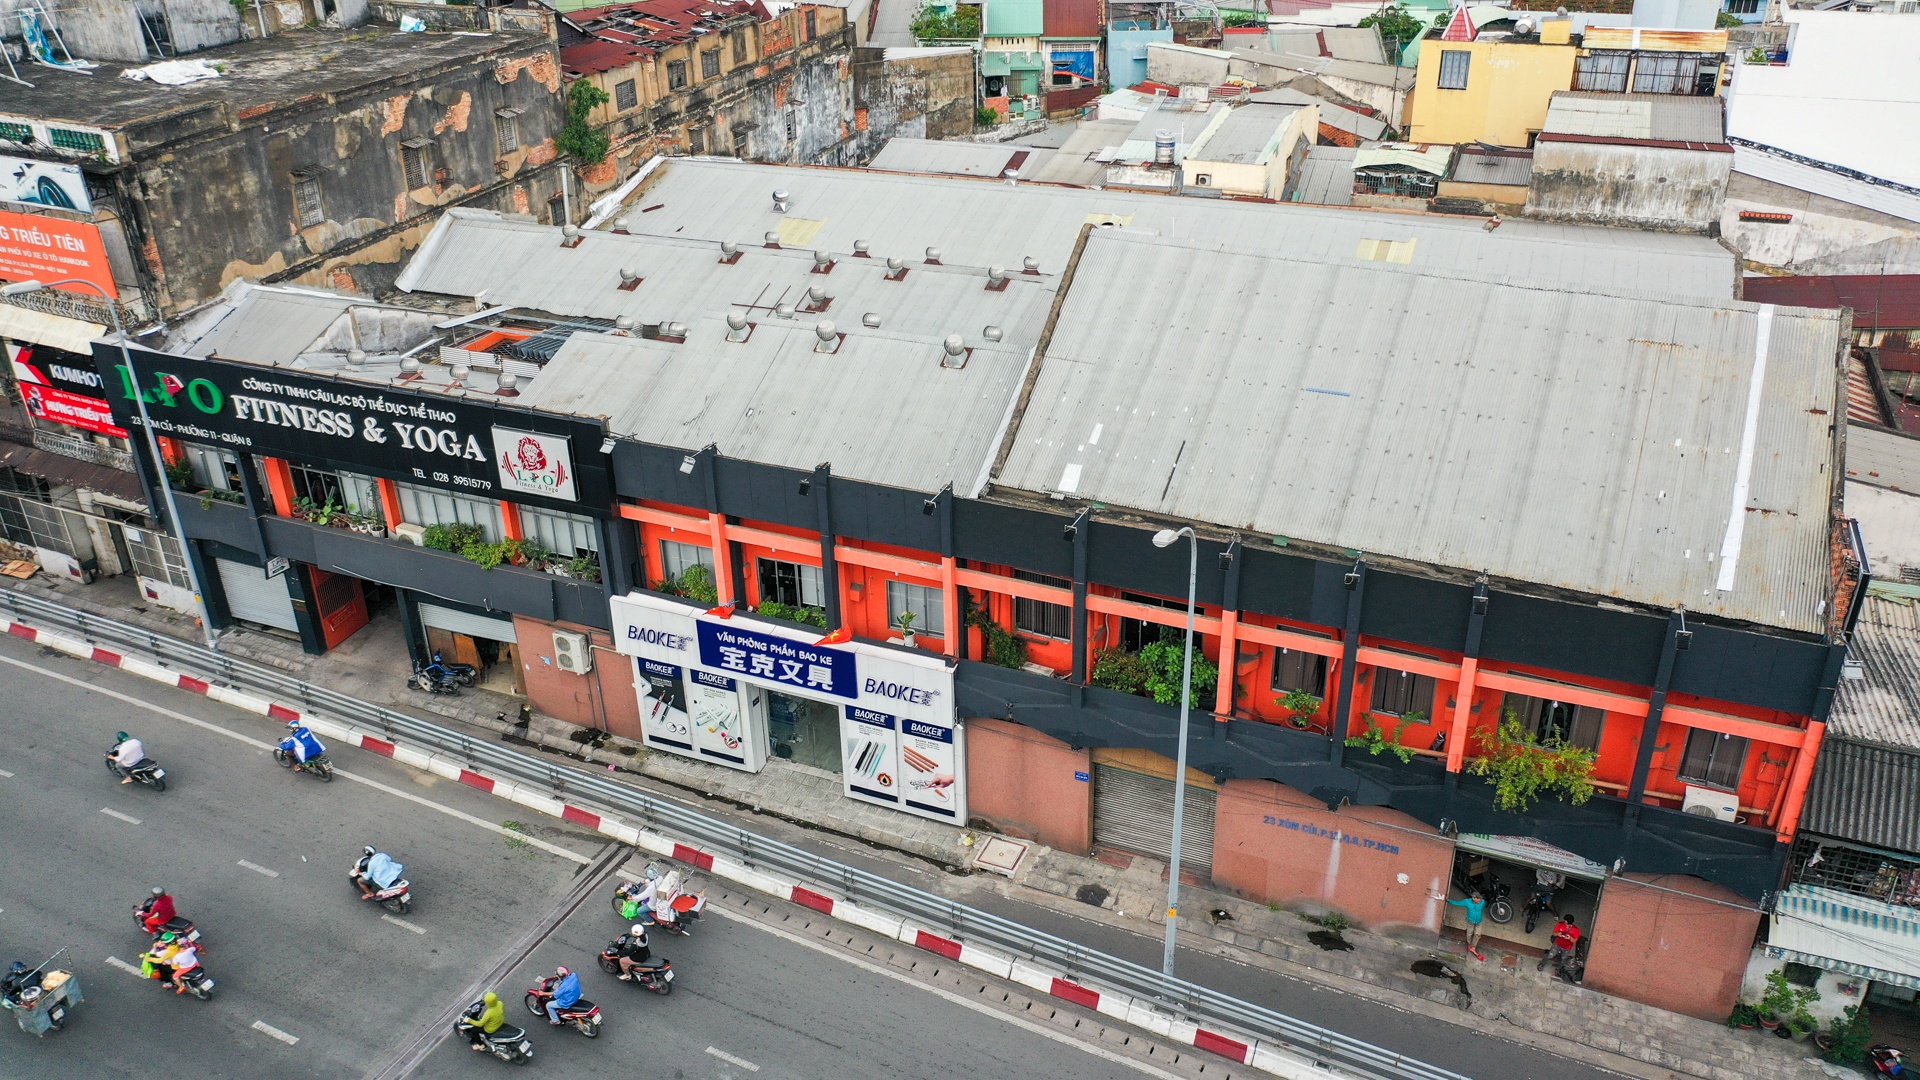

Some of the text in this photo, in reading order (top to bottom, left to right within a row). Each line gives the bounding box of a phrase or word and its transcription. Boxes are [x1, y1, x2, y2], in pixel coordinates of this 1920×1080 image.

[52, 233, 86, 253] TIÊN
[58, 256, 91, 267] HANKOOK
[49, 363, 98, 388] KUMHO
[242, 377, 456, 424] CÔNG TY TNHH CÂU LẠC BỘ THỂ DỤC THỂ THAO
[131, 415, 142, 426] 23
[160, 420, 173, 432] CỦI
[177, 424, 209, 438] PHƯỜNG
[209, 431, 217, 440] 11
[221, 433, 246, 445] QUẬN
[245, 437, 252, 446] 8
[230, 394, 487, 462] FITNESS & YOGA
[412, 467, 492, 491] TEL 028 39515779
[516, 480, 536, 488] Fitness
[545, 485, 559, 493] Yoga
[628, 624, 677, 649] BAOKE
[716, 631, 735, 644] VĂN
[737, 636, 768, 651] PHÒNG
[799, 650, 817, 662] BAO
[820, 655, 833, 666] KE
[645, 661, 667, 673] BAOKE
[698, 672, 723, 685] BAOKE
[719, 645, 834, 691] 宝克文具
[864, 677, 920, 704] BAOKE
[854, 708, 881, 721] BAOKE
[911, 722, 937, 736] BAOKE
[1263, 816, 1276, 825] 23
